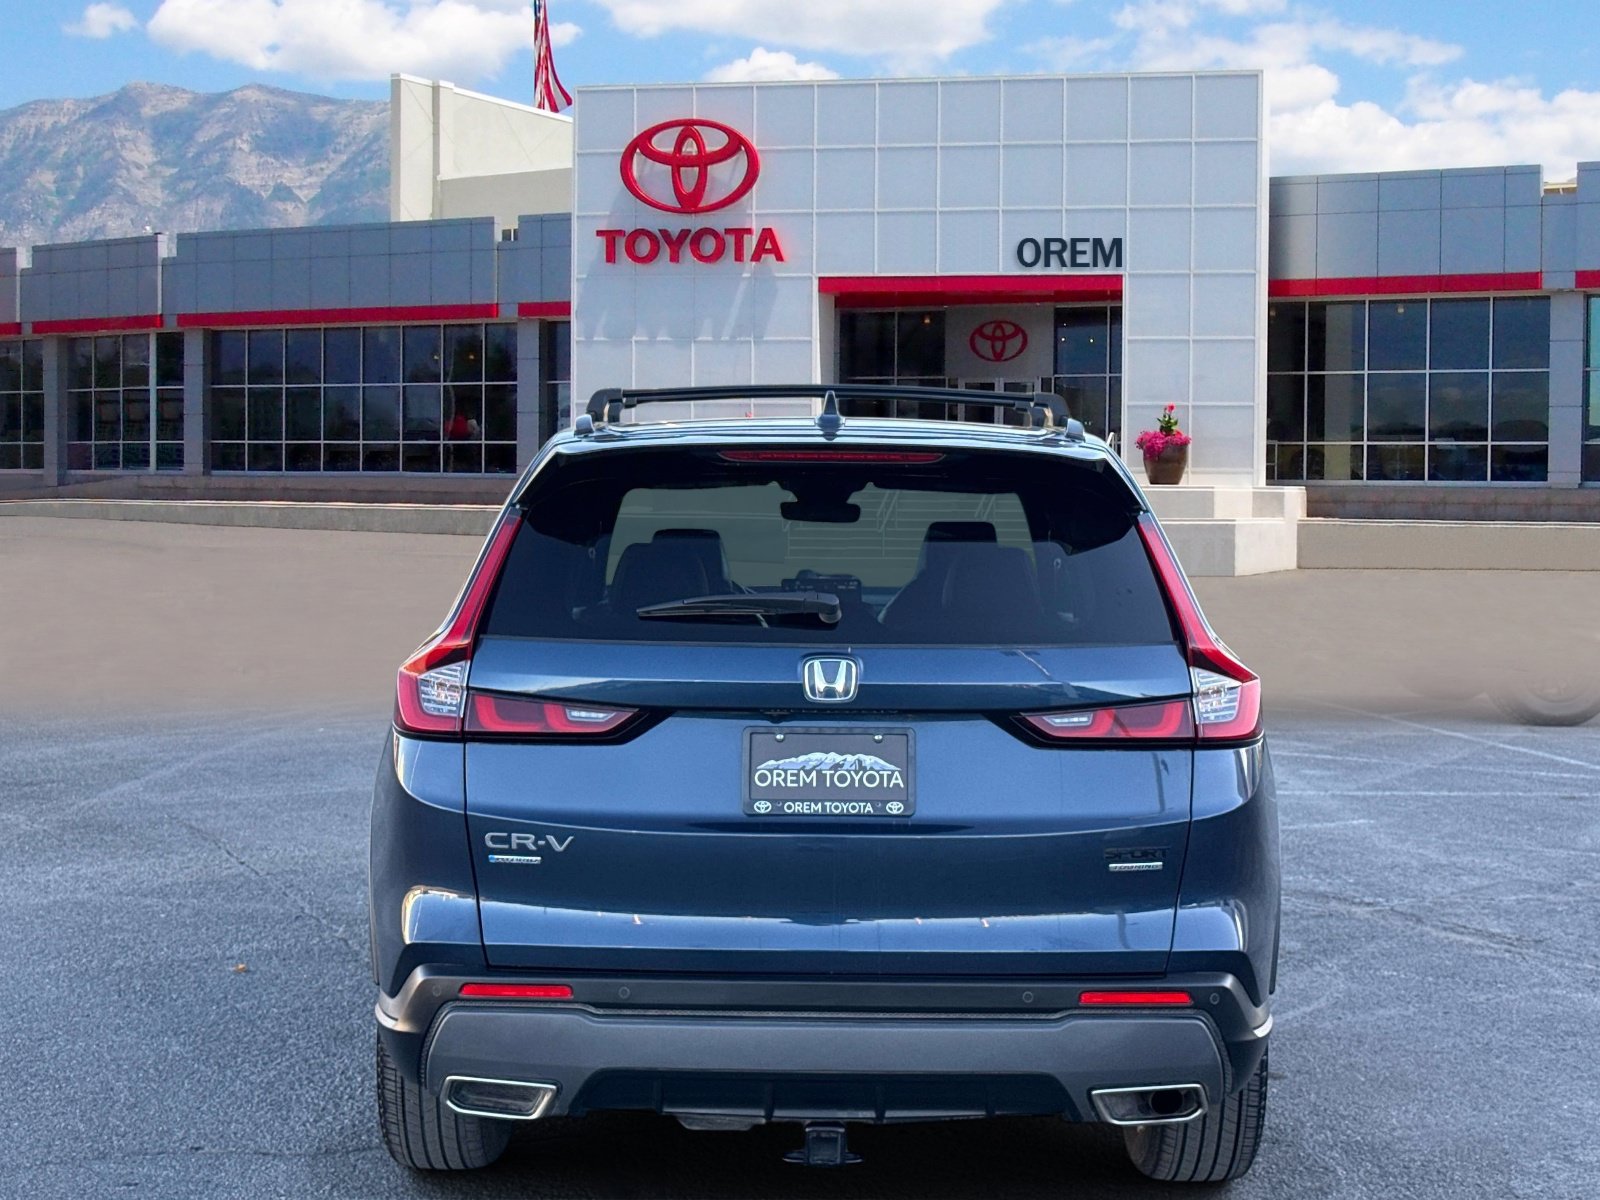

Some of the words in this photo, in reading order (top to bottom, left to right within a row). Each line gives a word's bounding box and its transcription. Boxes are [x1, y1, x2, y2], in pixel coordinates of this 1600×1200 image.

[596, 227, 785, 264] TOYOTA
[1016, 237, 1123, 269] OREM
[754, 769, 817, 788] OREM
[822, 770, 904, 788] TOYOTA
[783, 801, 822, 814] OREM
[824, 801, 873, 814] TOYOTA
[484, 832, 575, 853] CR-V
